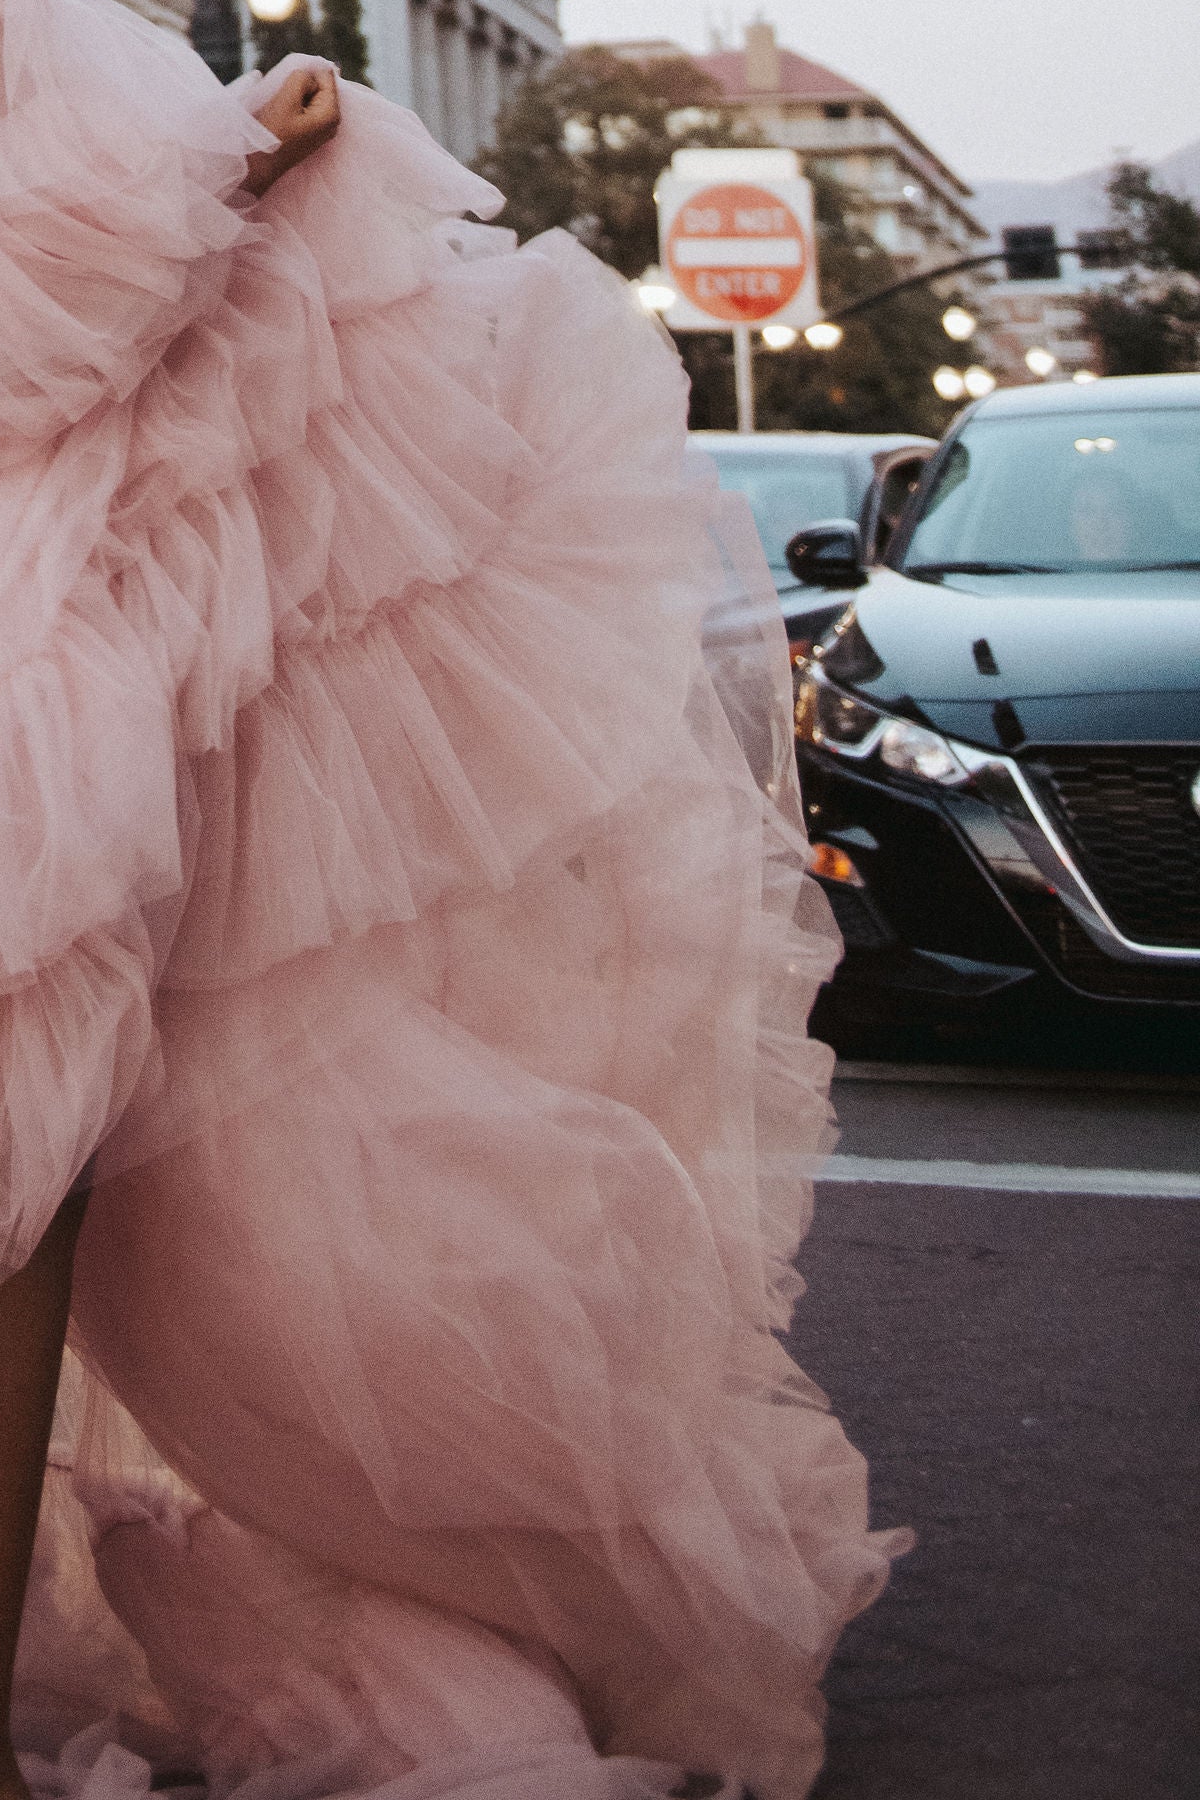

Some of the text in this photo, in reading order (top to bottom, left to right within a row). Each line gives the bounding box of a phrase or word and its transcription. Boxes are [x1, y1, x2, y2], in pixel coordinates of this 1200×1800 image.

[684, 208, 785, 232] DO NOT
[697, 272, 780, 297] ENTER
